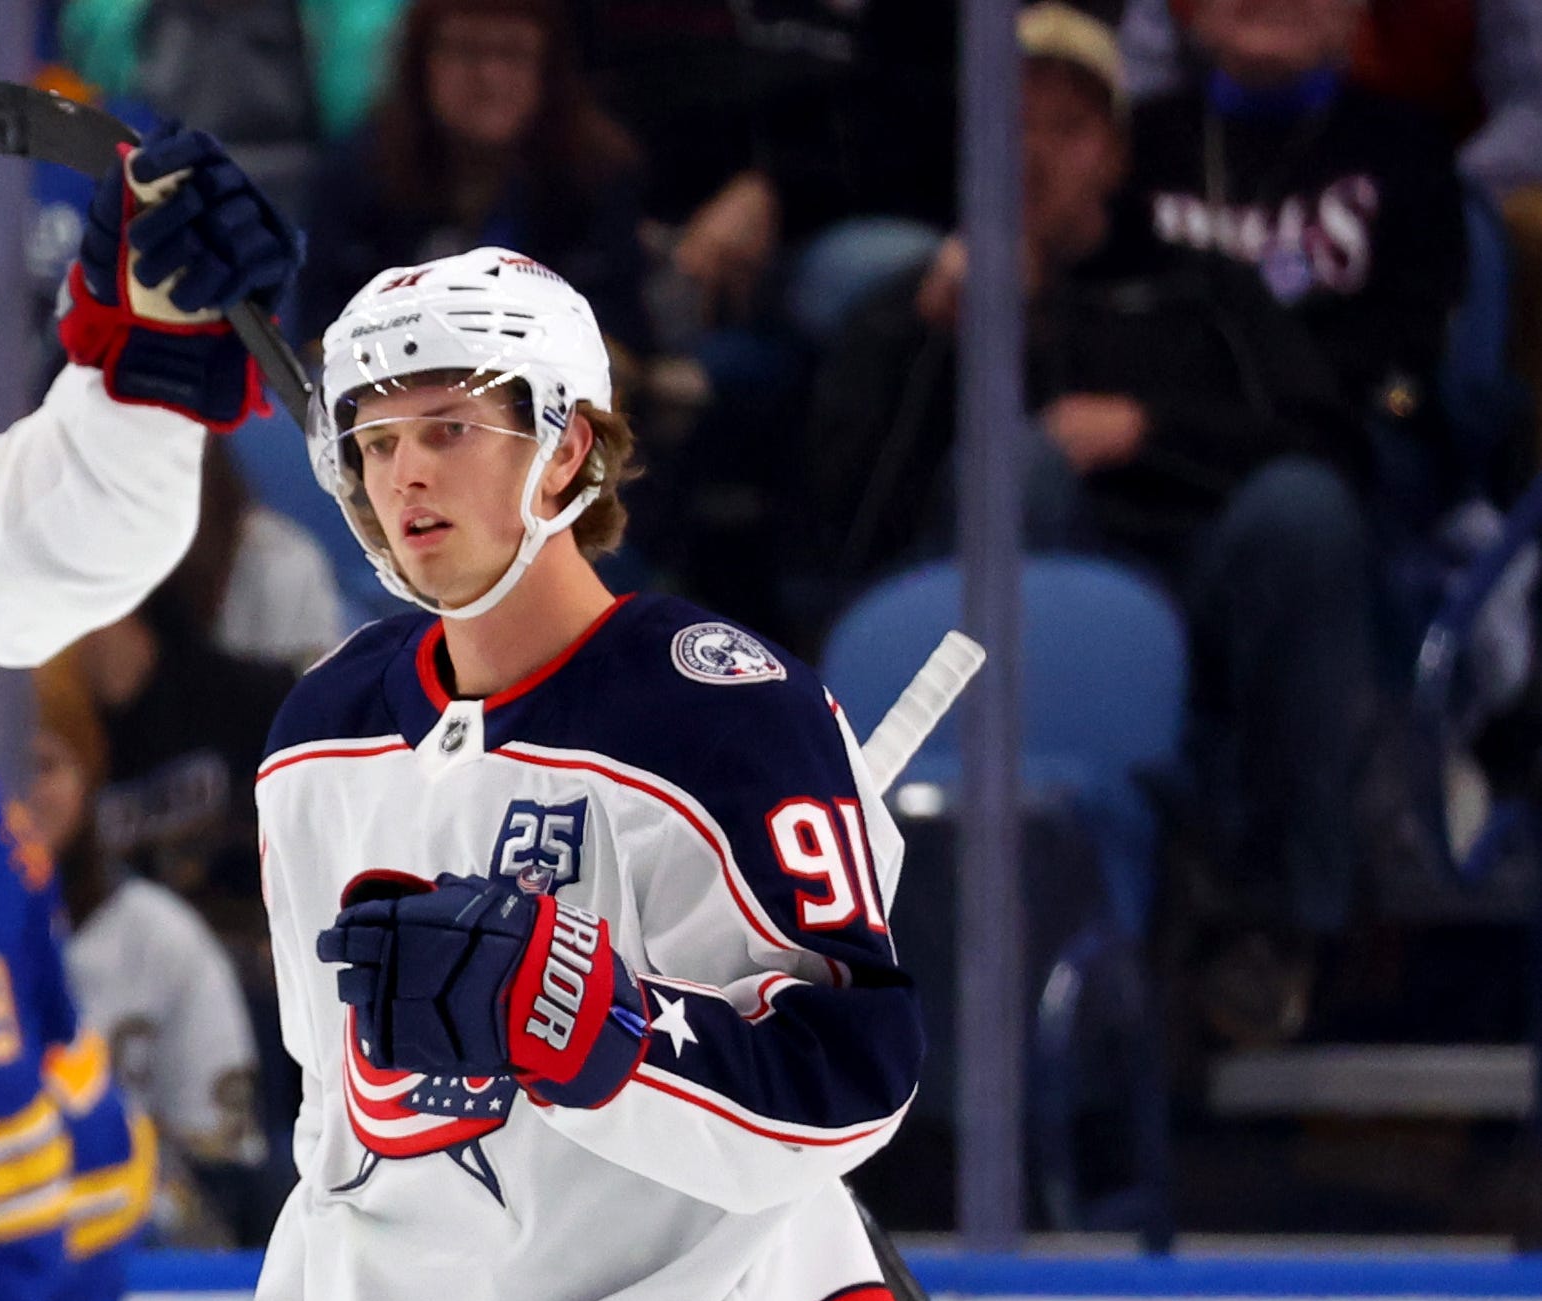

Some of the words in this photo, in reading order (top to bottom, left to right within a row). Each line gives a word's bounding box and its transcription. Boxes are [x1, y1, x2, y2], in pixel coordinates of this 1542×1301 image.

[499, 813, 575, 881] 25
[767, 797, 887, 934] 91
[526, 899, 600, 1052] RRIOR
